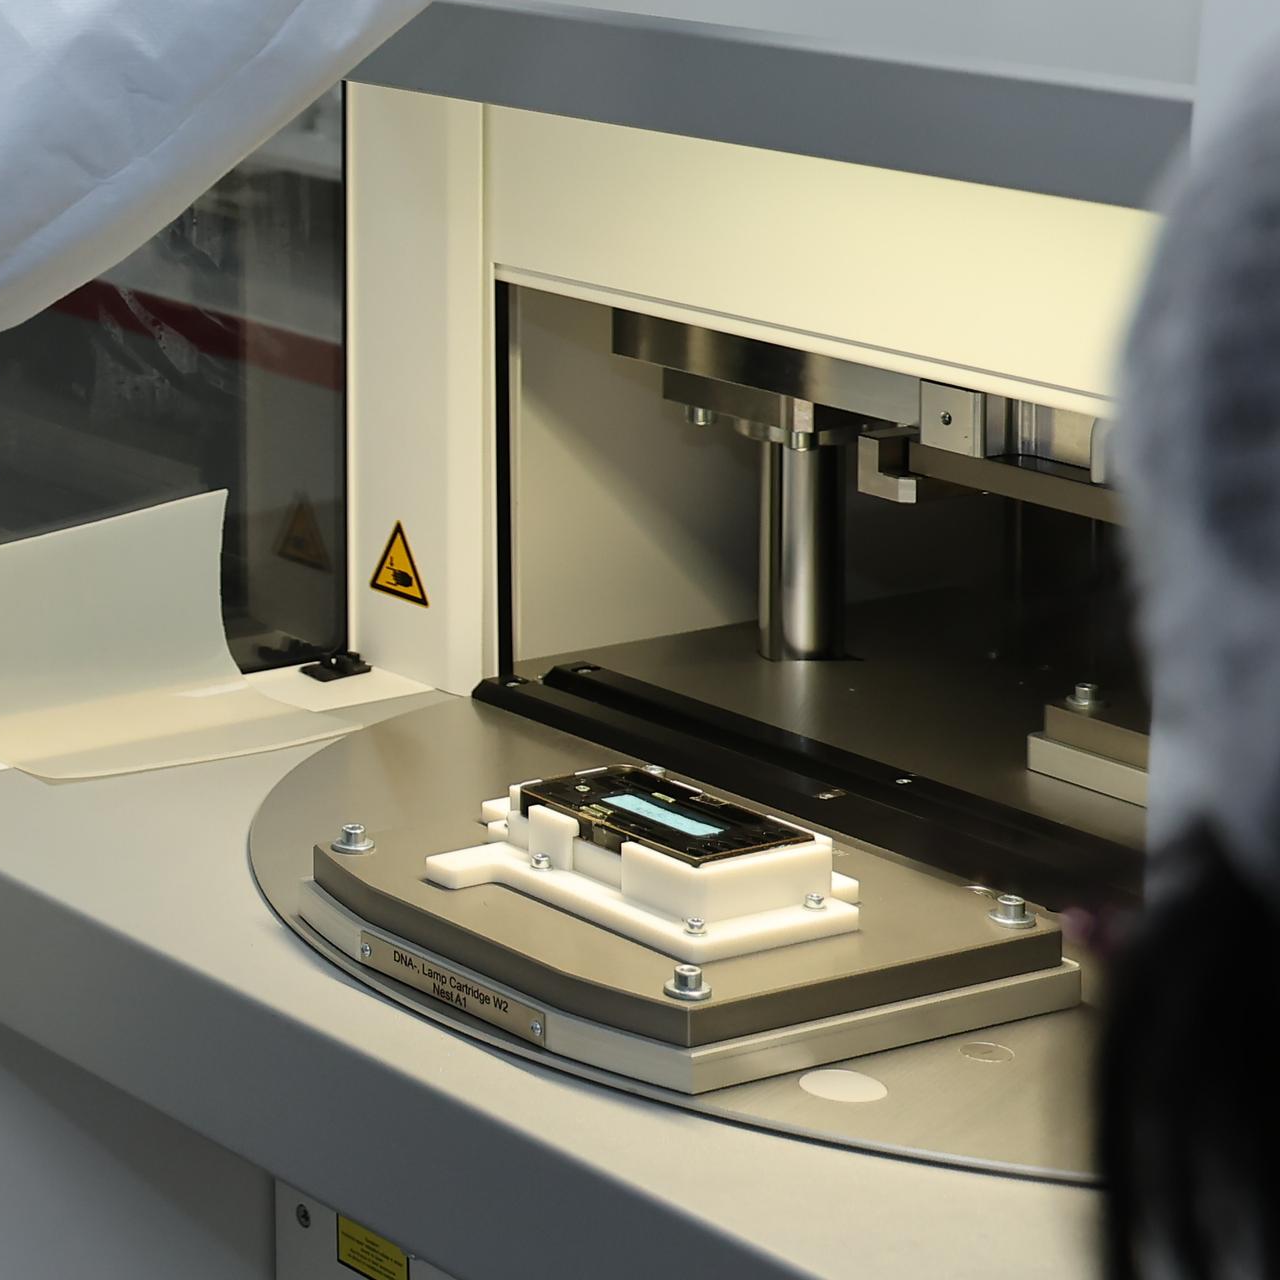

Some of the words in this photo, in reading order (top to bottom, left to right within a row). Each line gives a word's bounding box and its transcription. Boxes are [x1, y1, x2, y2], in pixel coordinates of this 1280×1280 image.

[421, 964, 448, 987] Lamp
[449, 975, 491, 1006] Cartridge
[493, 996, 509, 1013] W2
[432, 982, 454, 1004] Nest
[455, 993, 467, 1008] A1
